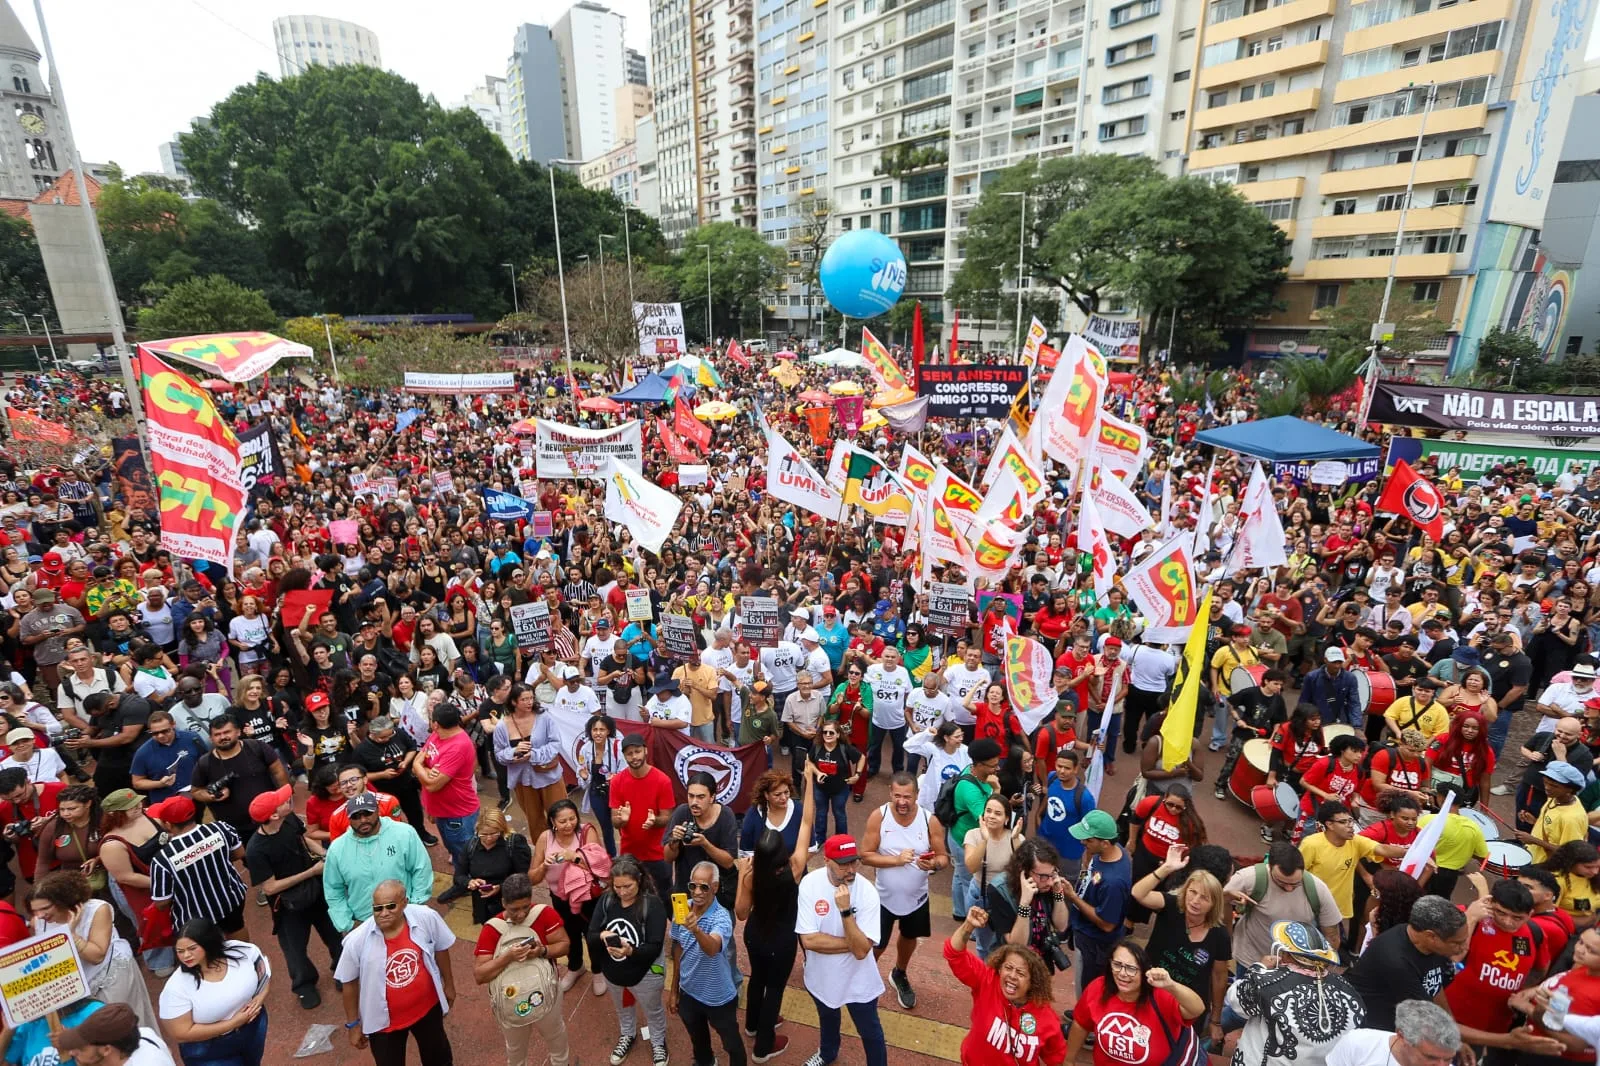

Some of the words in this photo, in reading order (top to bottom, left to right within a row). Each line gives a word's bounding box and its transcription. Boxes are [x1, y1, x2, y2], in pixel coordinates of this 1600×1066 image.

[922, 370, 953, 382] SEM
[957, 370, 1023, 382] ANISTIA!
[936, 382, 1008, 393] CONGRESSO
[971, 394, 988, 404] DO
[991, 394, 1016, 404] POV
[1392, 396, 1430, 414] VAT
[1443, 392, 1484, 418] NÃO
[1491, 398, 1506, 420] A
[1513, 400, 1598, 423] ESCALA
[1467, 420, 1490, 428] Pelo
[1492, 421, 1518, 430] vida
[1521, 422, 1549, 431] além
[1552, 424, 1568, 432] do
[1102, 426, 1140, 451] CTB
[600, 444, 634, 453] REFORMAS
[1007, 454, 1041, 494] CTB
[1533, 457, 1559, 476] DA
[1160, 561, 1188, 622] CTB
[774, 656, 793, 667] 6x1
[877, 689, 899, 700] 6x1
[250, 717, 264, 726] ute
[174, 837, 222, 866] DEMOCRACIA
[1480, 963, 1524, 991] PCdoB
[986, 1016, 1039, 1062] MTST
[1108, 1048, 1135, 1061] BRASIL
